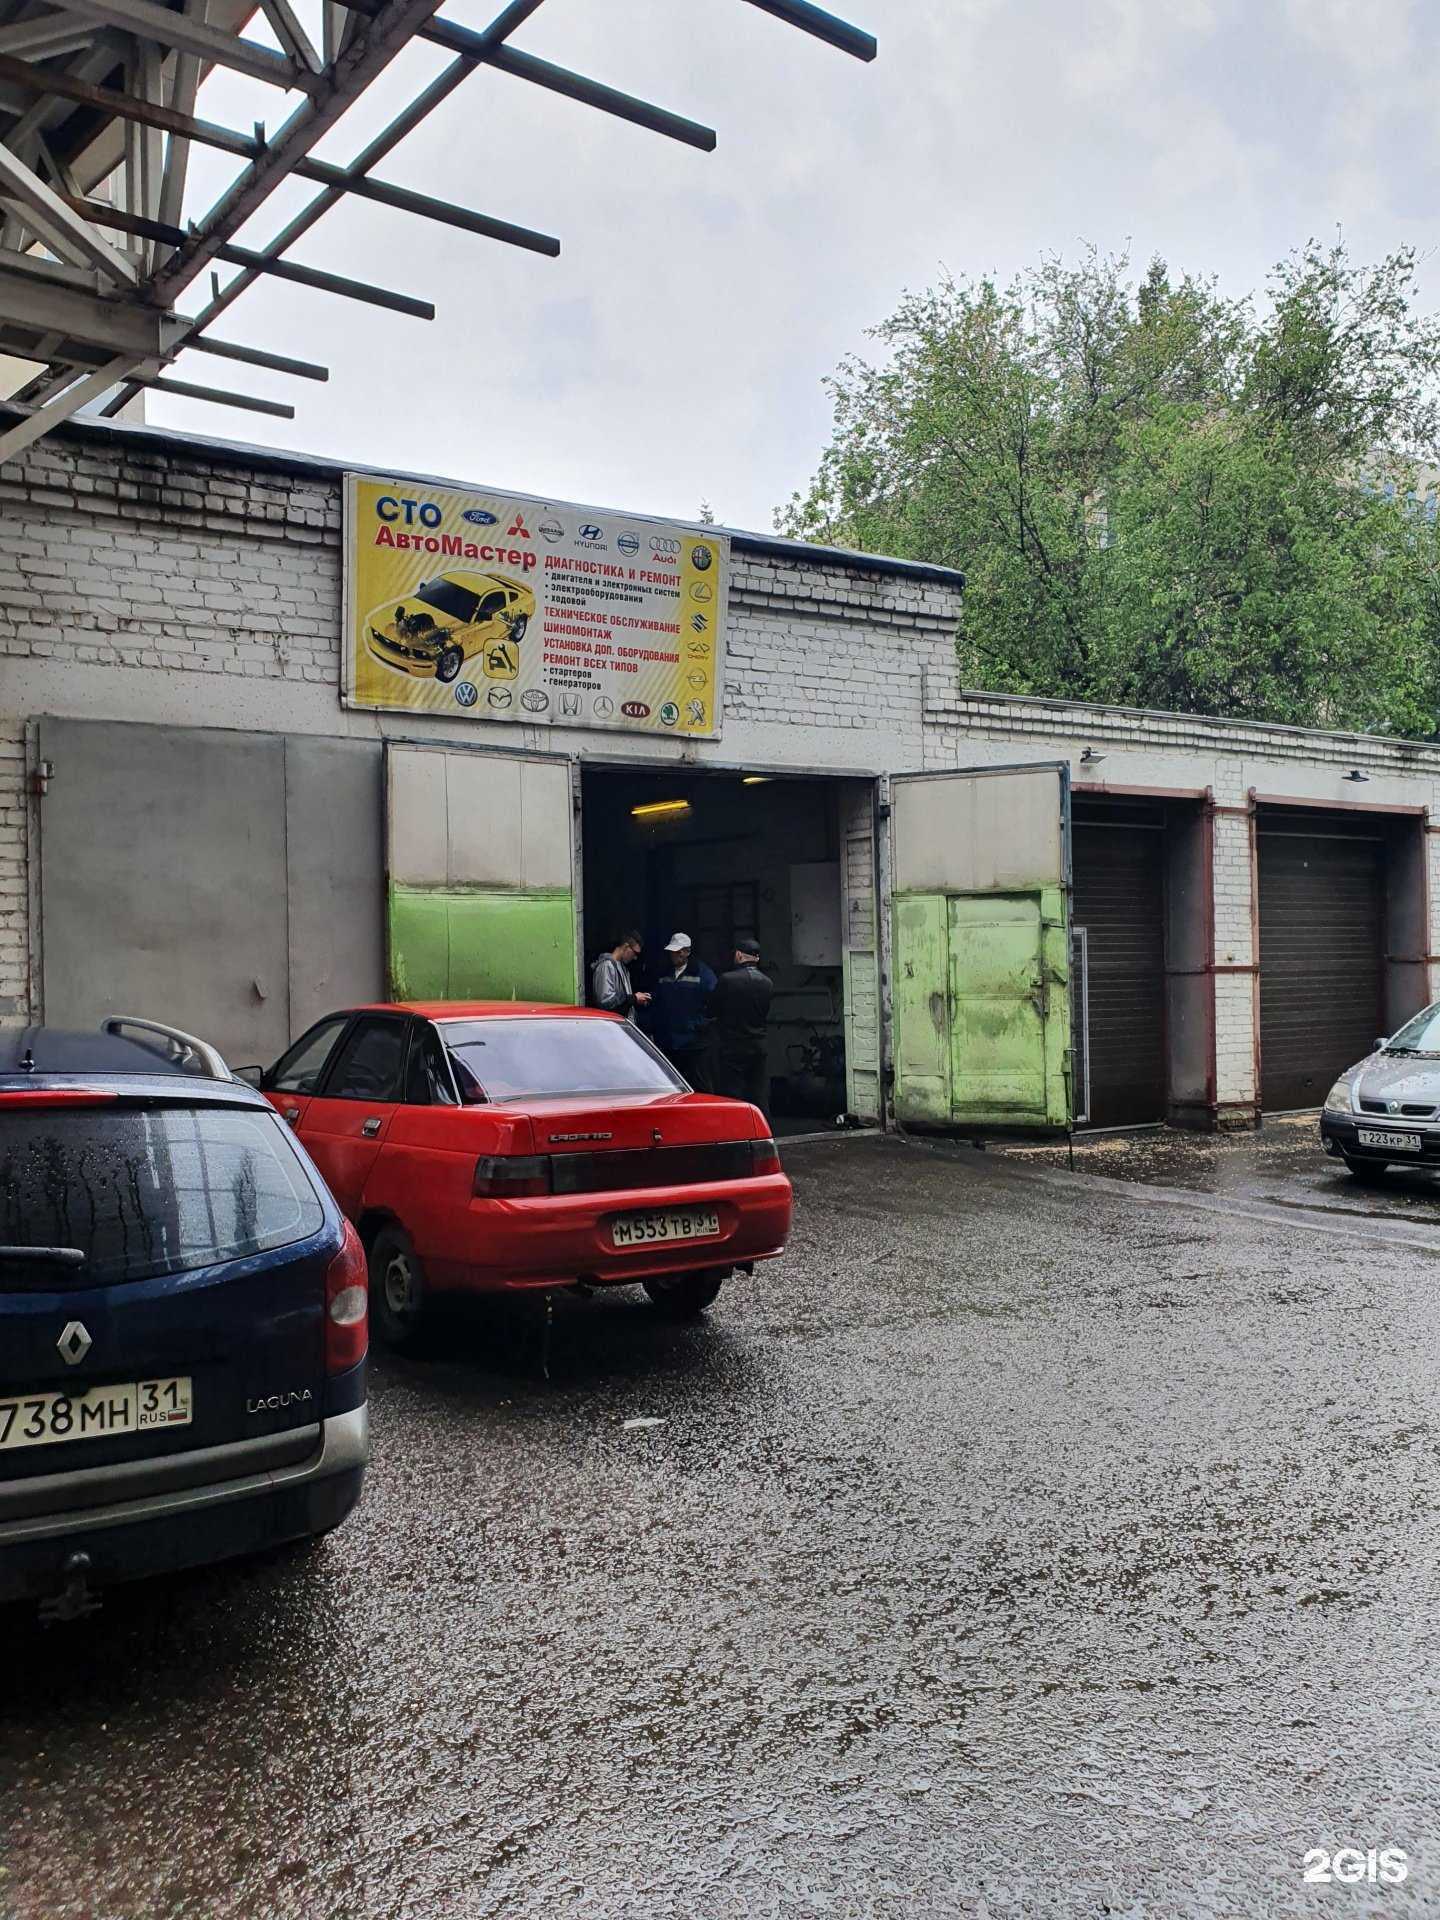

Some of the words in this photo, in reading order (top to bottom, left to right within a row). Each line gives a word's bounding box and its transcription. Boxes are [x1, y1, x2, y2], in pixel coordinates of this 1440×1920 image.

[376, 496, 442, 529] СТО
[375, 525, 537, 573] АвтоМастер
[574, 540, 608, 552] HYUNDAI
[652, 554, 677, 565] Audi
[544, 555, 625, 579] ДИАГНОСТИКА
[628, 569, 636, 579] И
[639, 571, 682, 587] РЕМОНТ
[551, 572, 593, 586] двигателя
[595, 579, 600, 587] и
[602, 580, 652, 595] электронных
[654, 587, 681, 599] систем
[551, 584, 644, 604] электрооборудования
[551, 595, 587, 607] ходовой
[544, 606, 608, 625] ТЕХНИЧЕСКОЕ
[610, 616, 681, 634] ОБСЛУЖИВАНИЕ
[543, 622, 613, 641] ШИНОМОНТАЖ
[543, 637, 594, 654] УСТАНОВКА
[594, 644, 615, 656] ДОП.
[617, 646, 680, 664] ОБОРУДОВАНИЯ
[543, 653, 581, 668] РЕМОНТ
[583, 658, 607, 670] ВСЕХ
[610, 661, 638, 673] ТИПОВ
[549, 667, 593, 679] стартеров
[549, 678, 602, 692] генераторов
[625, 704, 646, 715] KIA
[141, 1381, 179, 1412] 31
[246, 1389, 313, 1413] LAGUNA
[139, 1411, 167, 1425] RUS
